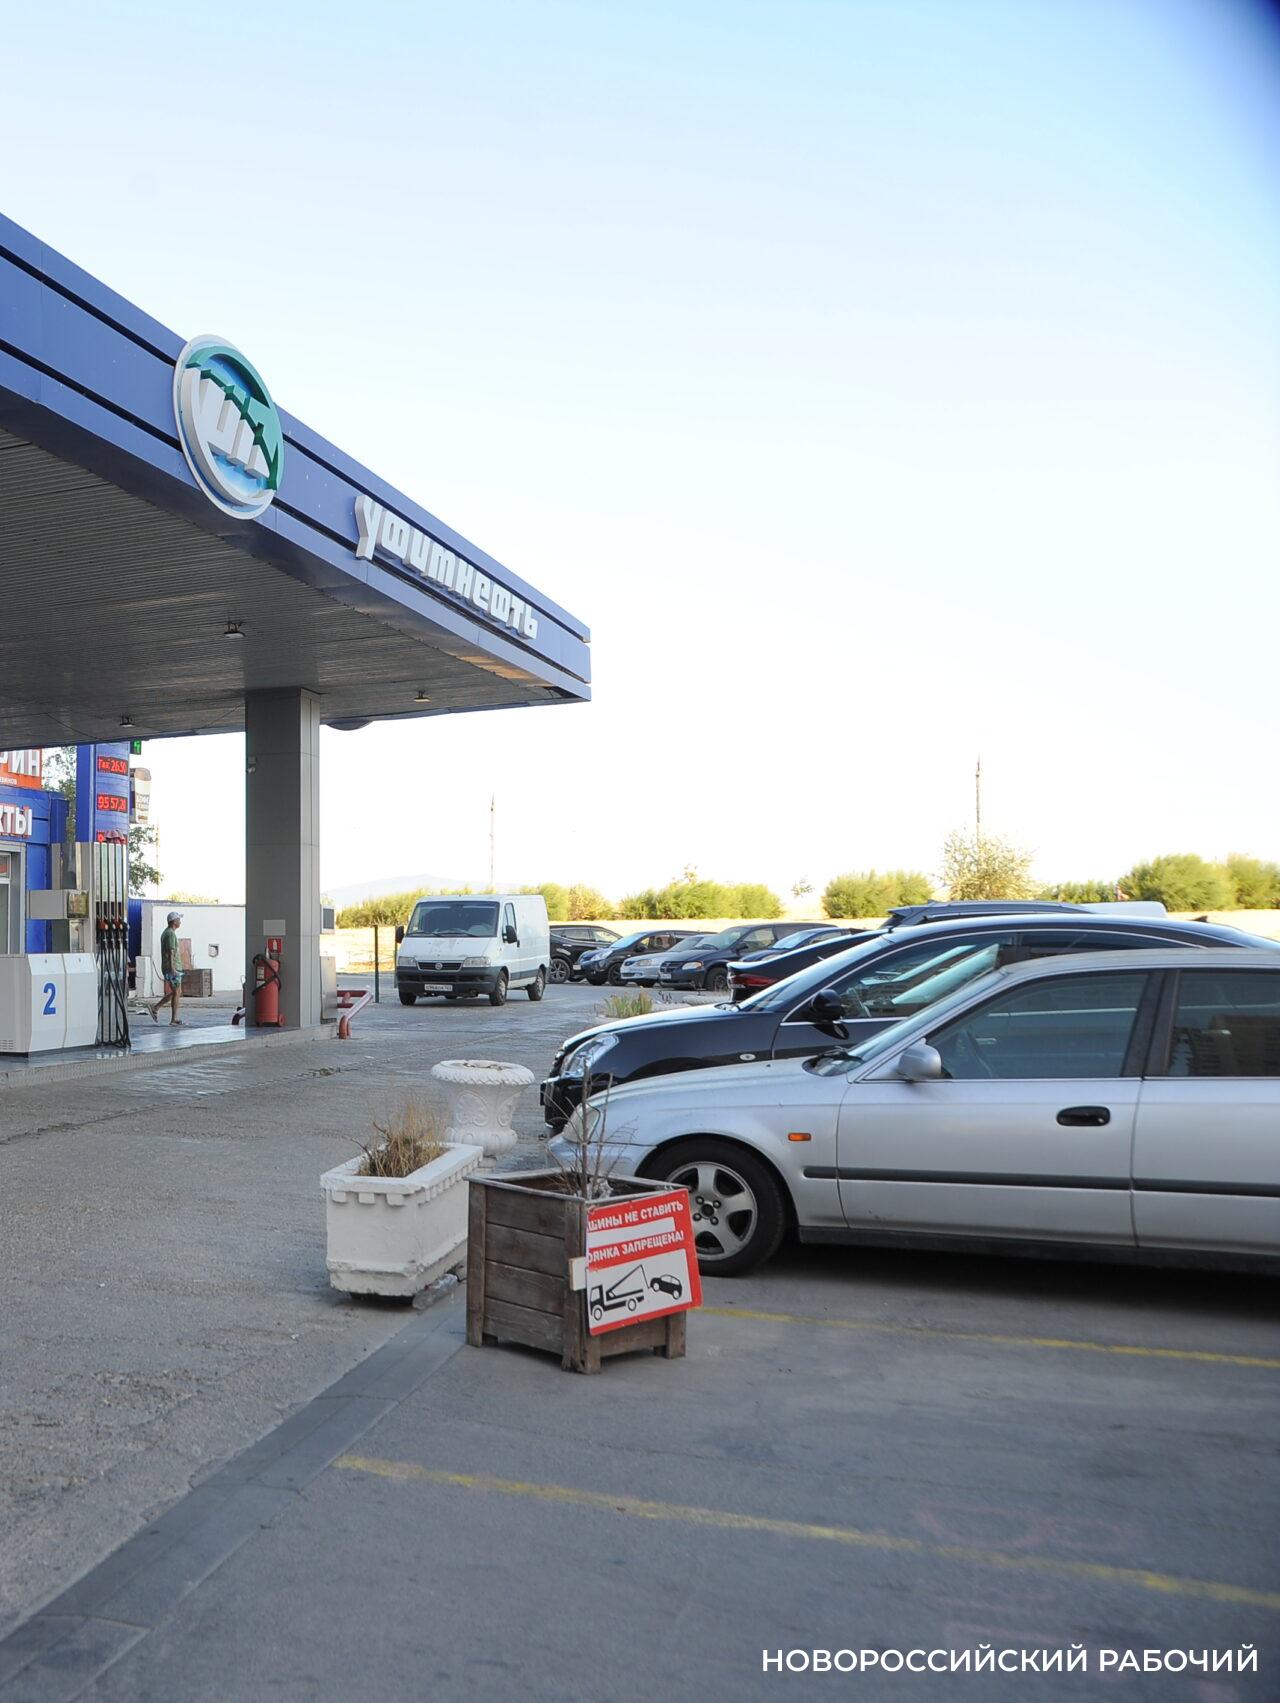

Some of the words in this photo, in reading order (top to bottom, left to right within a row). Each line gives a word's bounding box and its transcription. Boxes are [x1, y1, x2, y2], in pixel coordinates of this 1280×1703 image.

[98, 796, 110, 809] 95
[43, 982, 56, 1015] 2
[588, 1213, 622, 1231] ШИНЫ
[624, 1211, 639, 1224] НЕ
[640, 1200, 684, 1220] СТАВИТЬ
[587, 1245, 620, 1264] ОЯНКА
[622, 1229, 685, 1255] ЗАПРЕЩЕНА!
